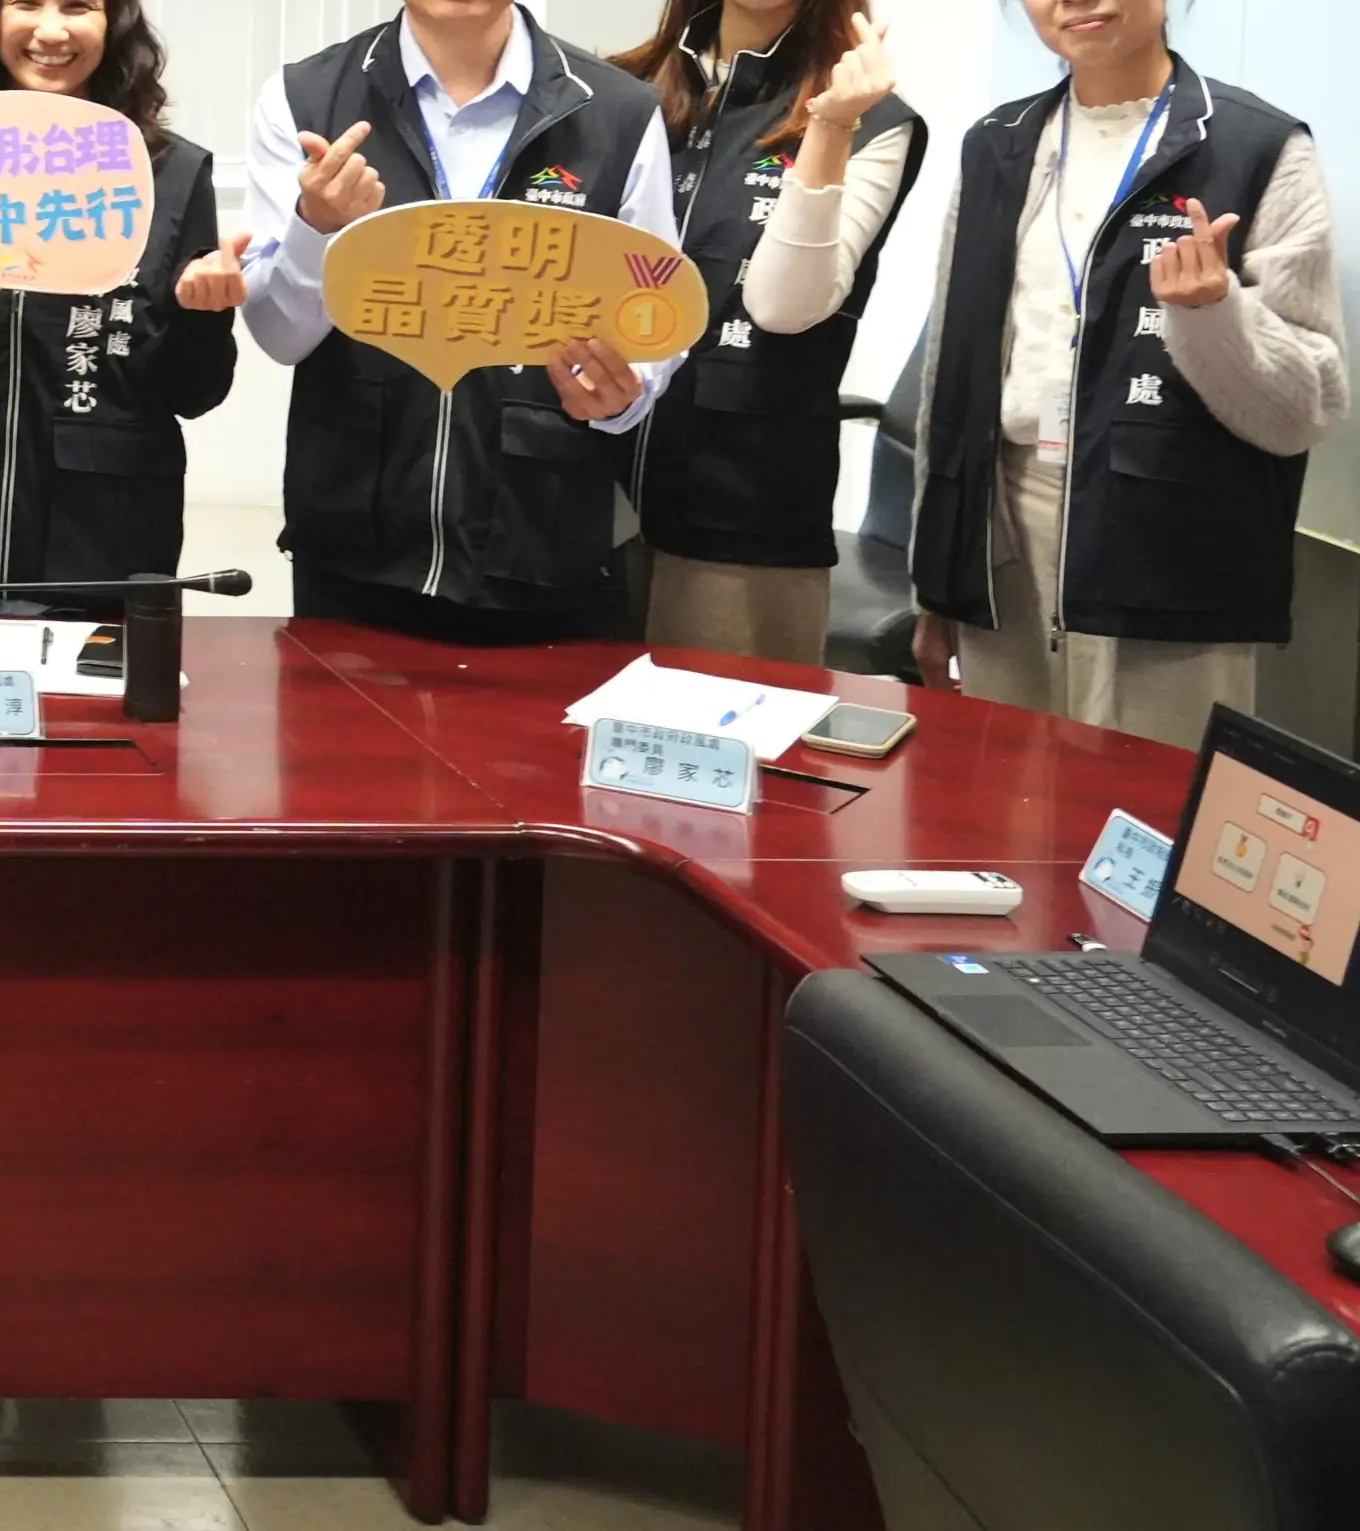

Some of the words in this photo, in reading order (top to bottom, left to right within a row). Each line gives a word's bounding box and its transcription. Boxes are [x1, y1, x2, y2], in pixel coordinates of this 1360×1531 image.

[414, 211, 578, 282] 透明
[352, 272, 605, 349] 晶質獎
[633, 302, 654, 336] 1
